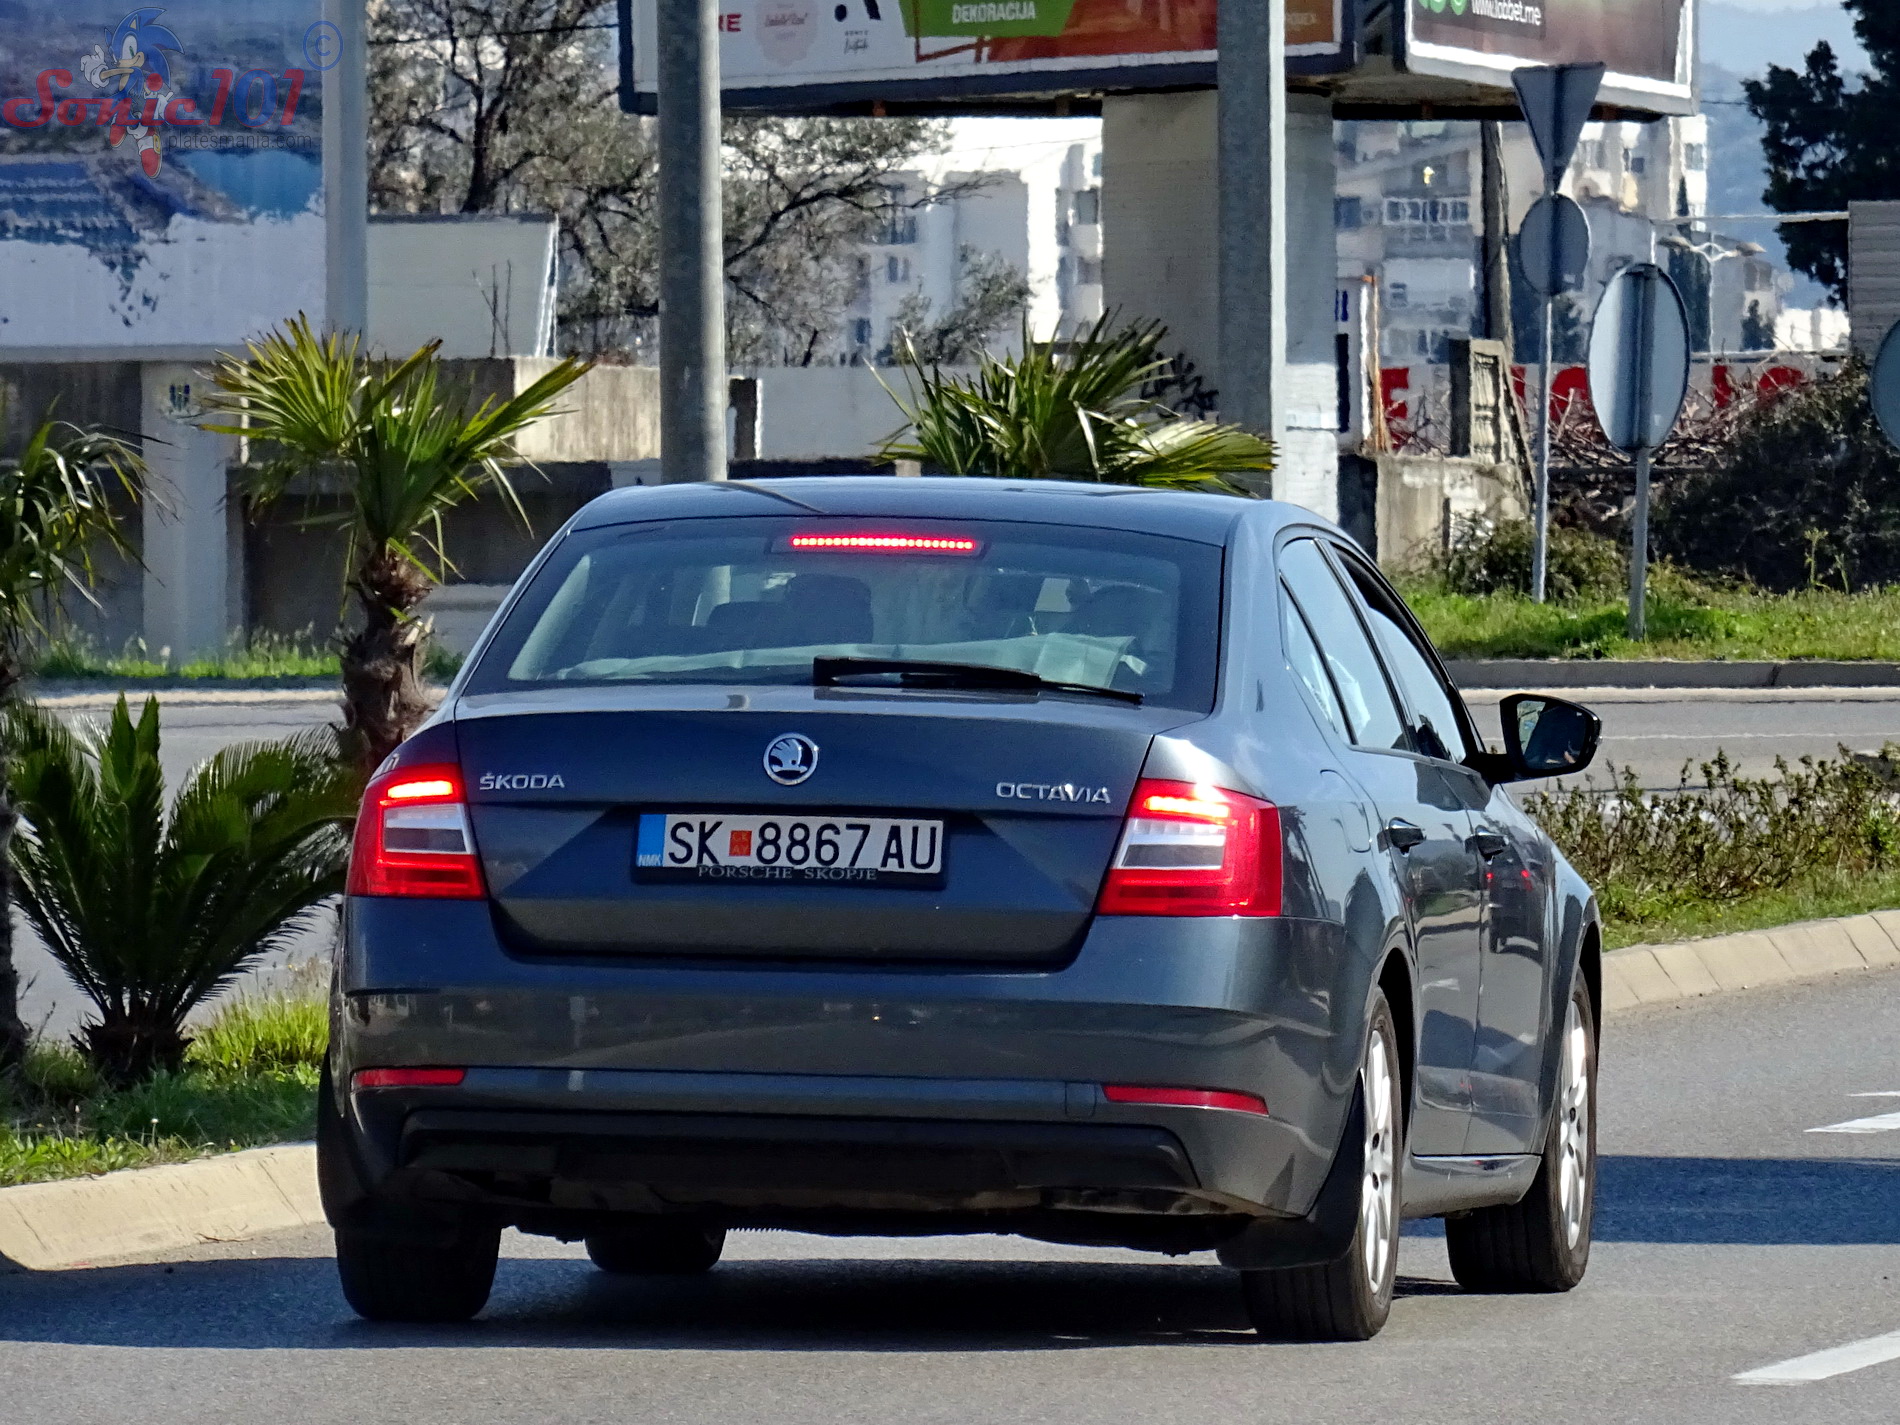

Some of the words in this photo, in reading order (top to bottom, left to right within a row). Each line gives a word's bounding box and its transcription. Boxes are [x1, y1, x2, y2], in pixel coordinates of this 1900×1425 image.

[952, 1, 1036, 24] DEKORACIJA
[479, 772, 565, 790] ŠKODA
[995, 781, 1111, 805] OCTAVIA
[668, 820, 723, 867] SK
[755, 821, 872, 867] 8867
[880, 825, 938, 870] AU
[697, 865, 794, 880] PORSCHE
[804, 866, 879, 881] SKOPJE
